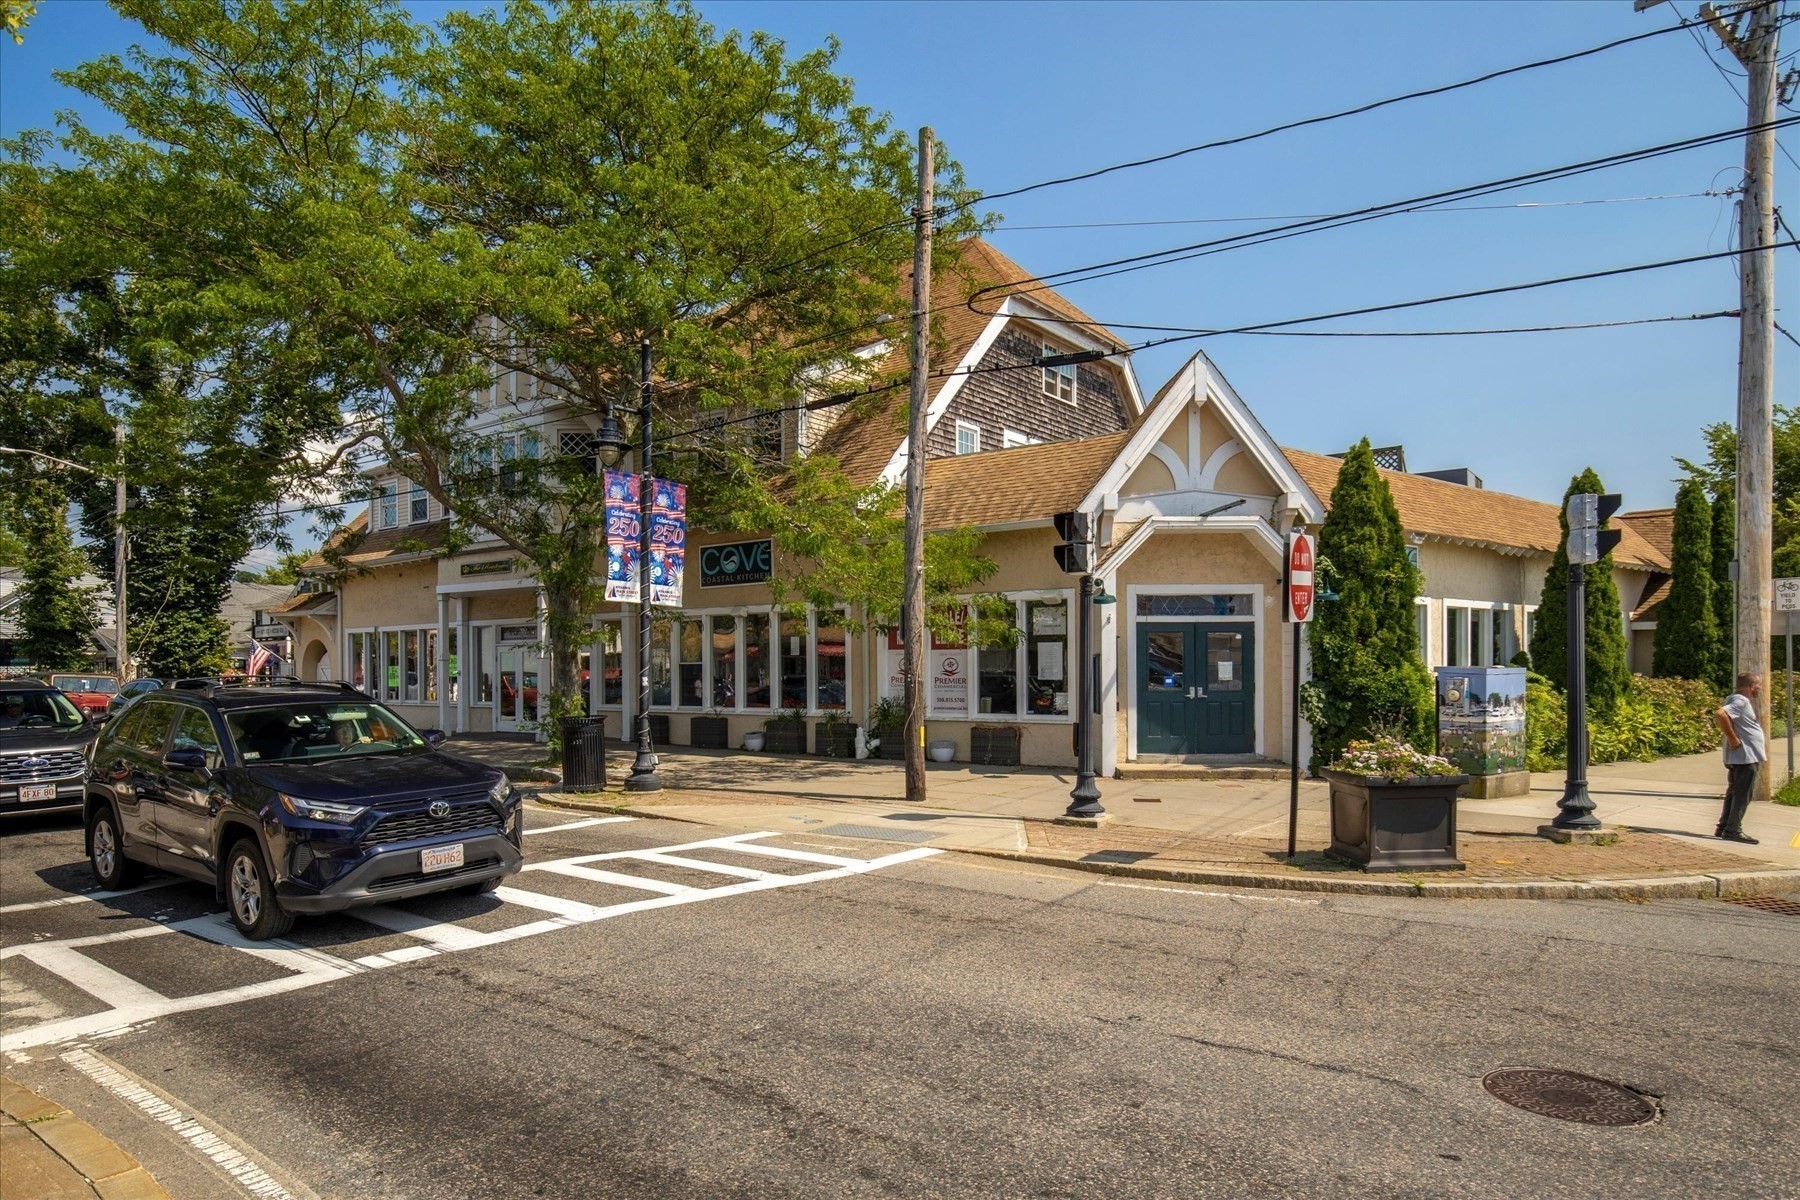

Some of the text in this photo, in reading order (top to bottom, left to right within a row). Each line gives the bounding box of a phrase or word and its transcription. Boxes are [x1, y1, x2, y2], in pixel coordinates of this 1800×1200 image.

[608, 517, 640, 537] 250
[652, 524, 685, 544] 250
[702, 542, 769, 575] COVE
[1294, 551, 1309, 566] DO NOT
[702, 574, 734, 584] COASTAL
[1294, 591, 1308, 605] ENTER
[934, 676, 967, 685] PREMIER
